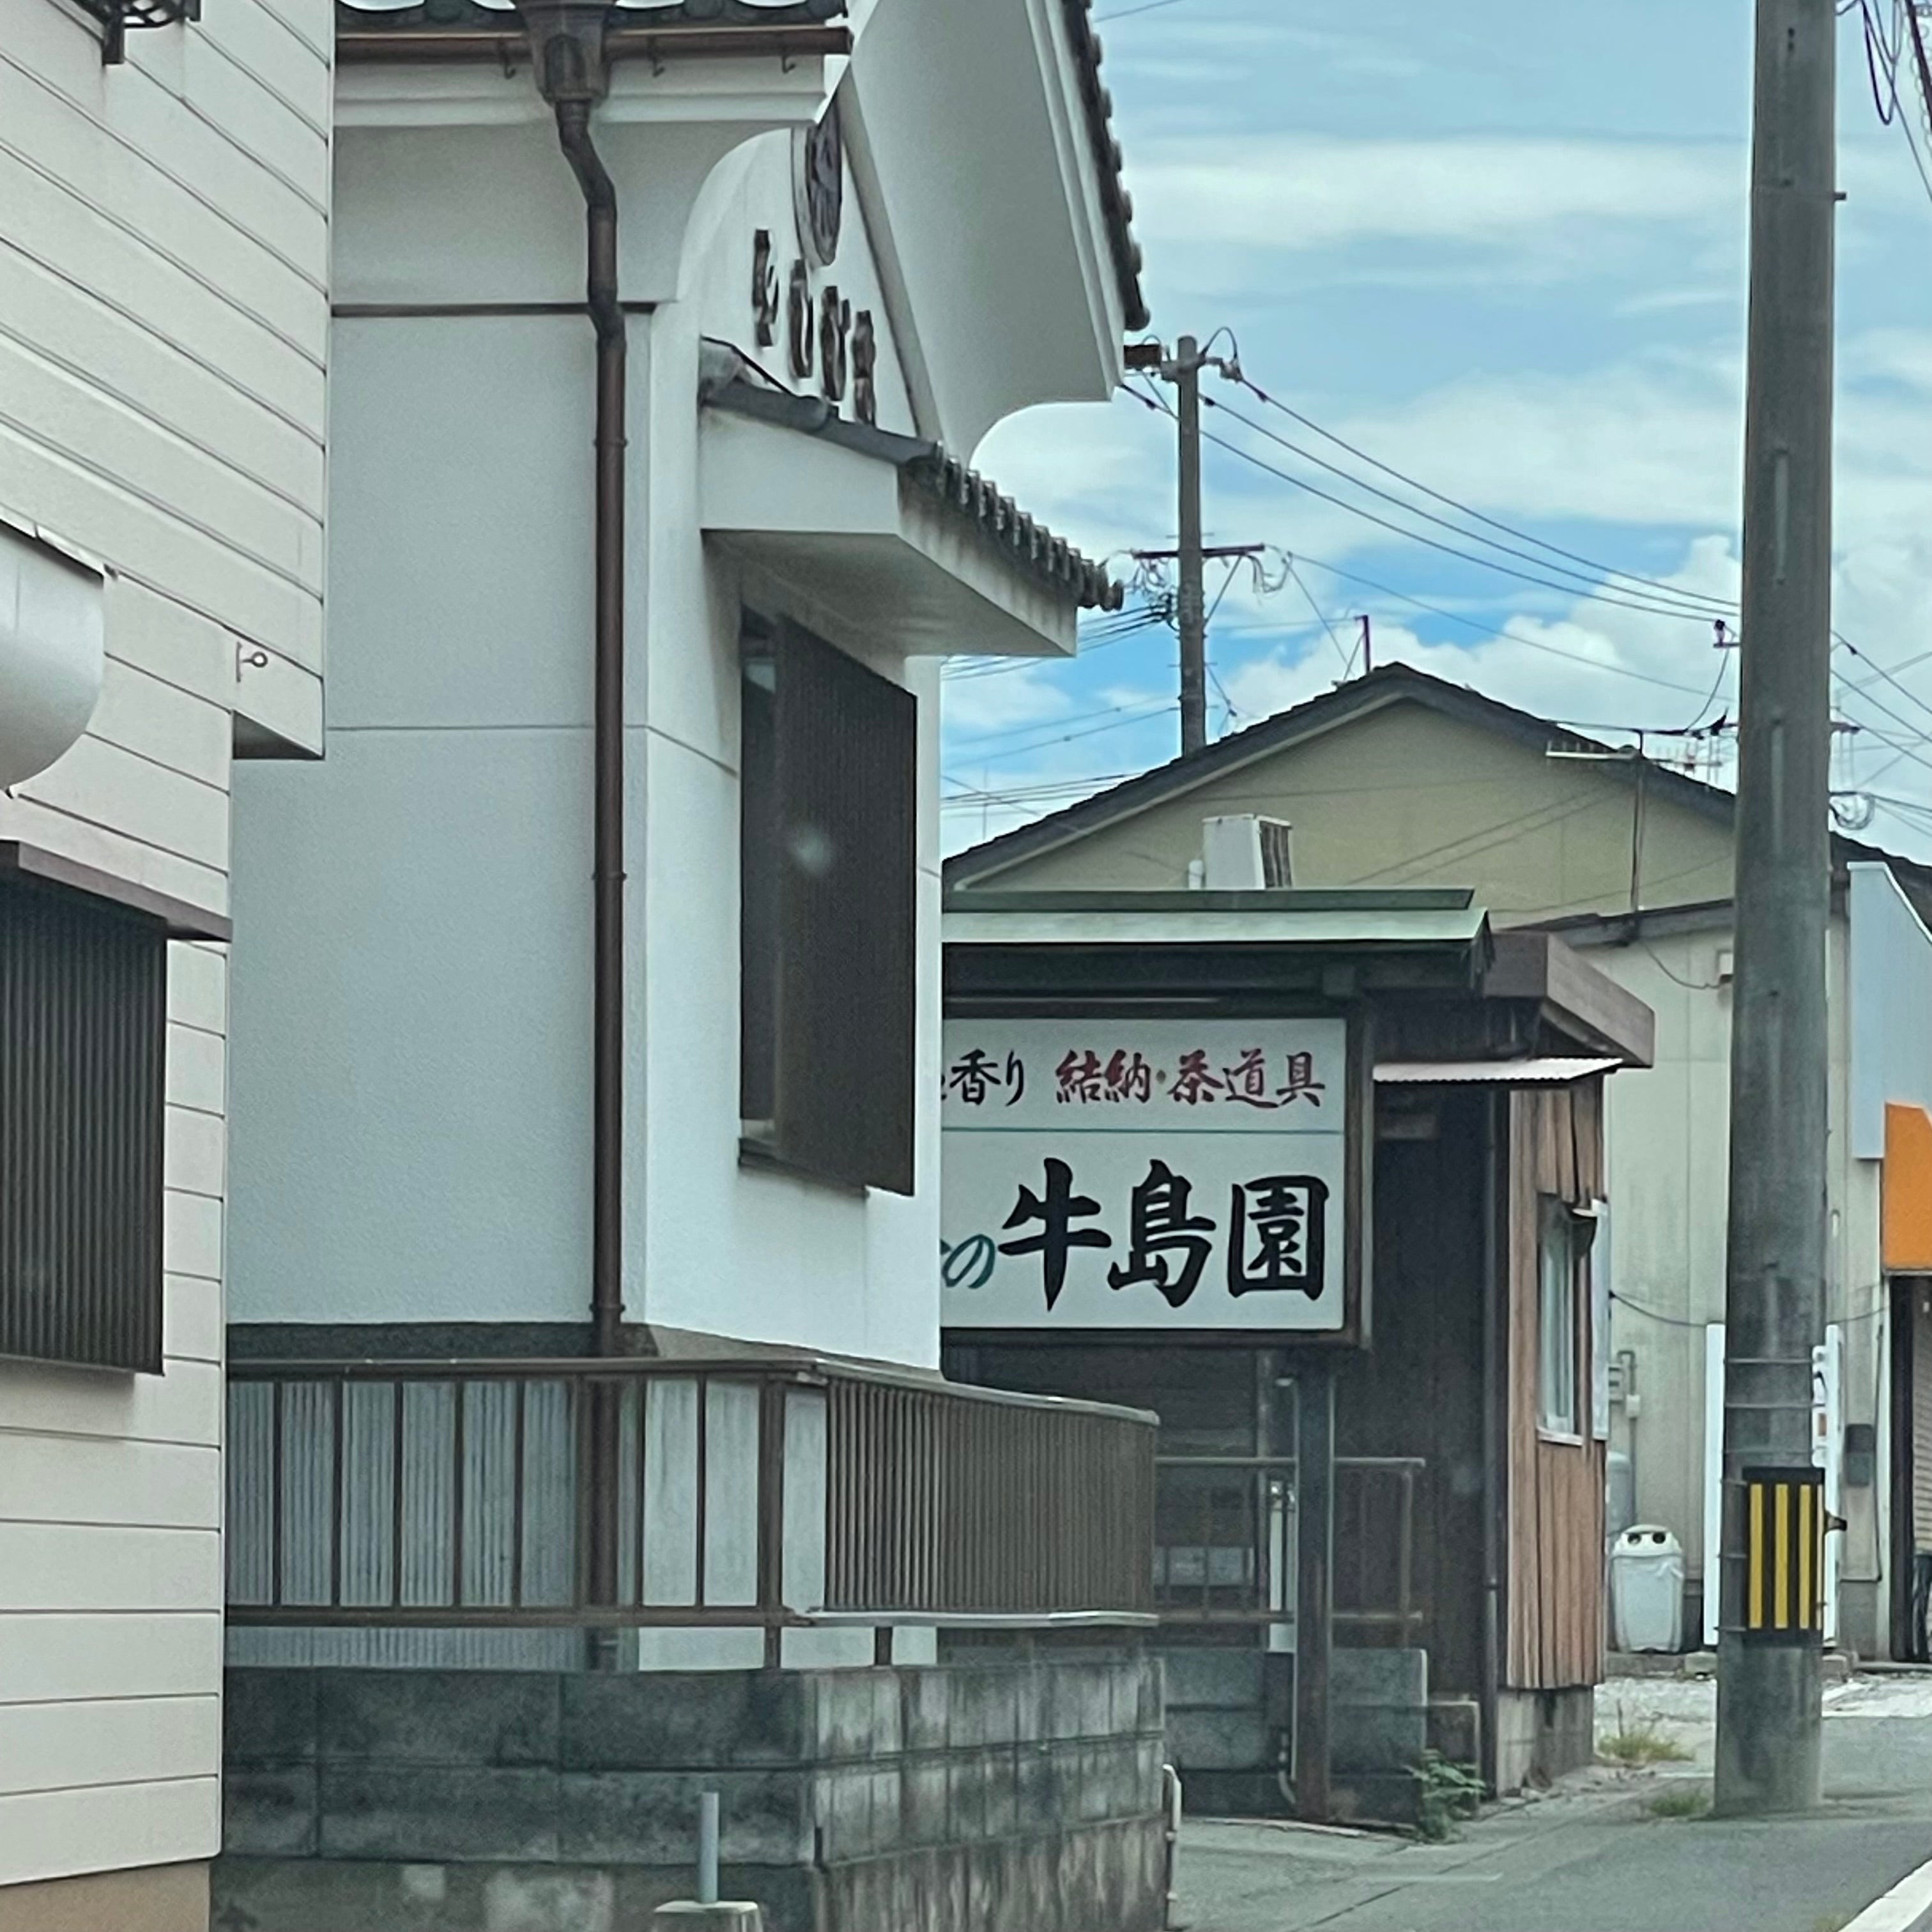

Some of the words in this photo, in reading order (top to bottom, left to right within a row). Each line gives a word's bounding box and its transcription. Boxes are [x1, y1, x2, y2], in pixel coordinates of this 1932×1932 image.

[942, 1048, 1024, 1107] 香り
[941, 1157, 1330, 1311] の牛島園
